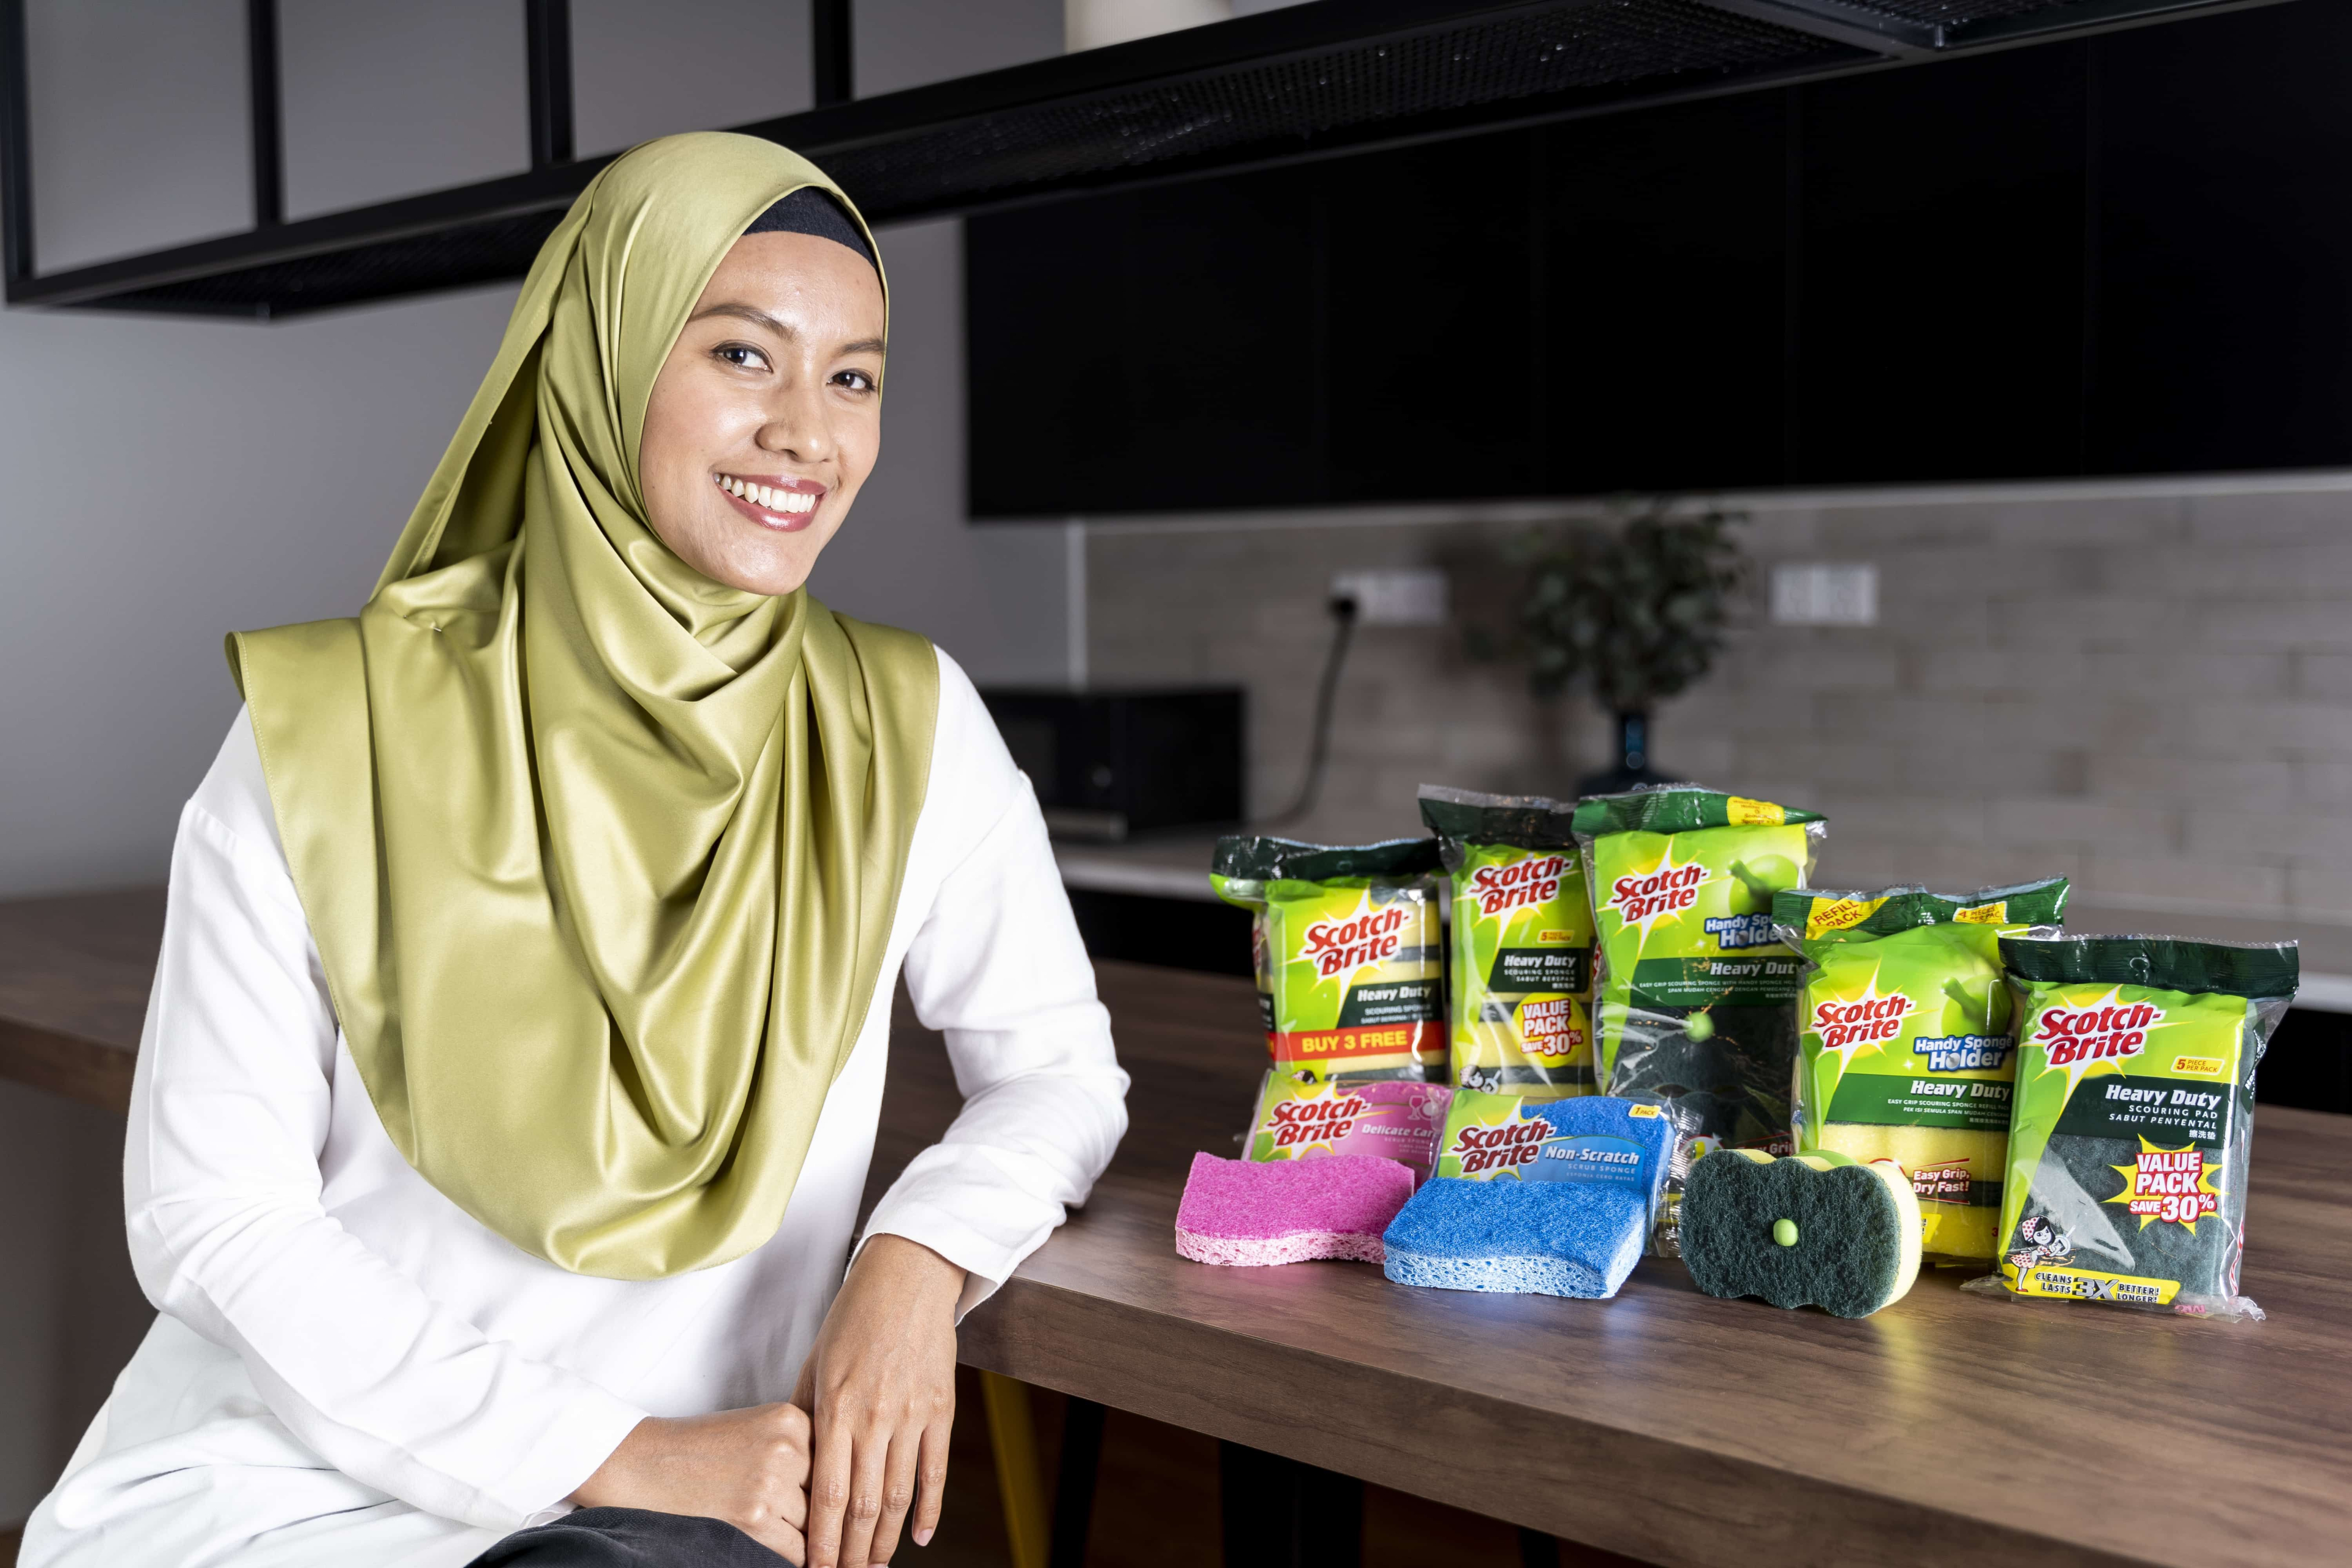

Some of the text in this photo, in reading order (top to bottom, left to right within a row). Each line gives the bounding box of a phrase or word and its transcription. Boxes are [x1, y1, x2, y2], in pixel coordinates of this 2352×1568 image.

[1470, 856, 1570, 893] Scotch-
[1611, 865, 1708, 903] Scotch-
[1480, 880, 1558, 914] Brite
[1622, 888, 1696, 922] Brite
[1814, 901, 1859, 925] REFILL
[1971, 906, 1995, 916] PIECES
[1986, 911, 2000, 919] PAC
[1305, 908, 1409, 954] Scotch-
[1706, 914, 1773, 932] Handy Spo
[1720, 925, 1780, 948] Holde
[1317, 935, 1398, 976] Brite
[1504, 955, 1577, 968] Heavy Duty
[1710, 962, 1762, 977] Heavy
[1357, 986, 1431, 1002] Heavy Duty
[1523, 999, 1570, 1019] VALUE
[1812, 995, 1912, 1028] Scotch-
[1523, 1015, 1569, 1037] PACK
[2034, 1005, 2162, 1040] Scotch-
[1302, 1030, 1408, 1053] BUY 3 FREE
[1521, 1031, 1583, 1056] SAVE 30%
[1823, 1019, 1899, 1049] Brite
[1915, 1036, 2013, 1052] Handy Sponge
[2046, 1031, 2144, 1065] Brite
[1930, 1049, 2002, 1070] Holder
[2176, 1058, 2187, 1070] 5
[1910, 1080, 2011, 1101] Heavy Duty
[2105, 1084, 2222, 1110] Heavy Duty
[1267, 1096, 1367, 1127] Scotch-
[2109, 1113, 2217, 1129] SABUT PENYENTAL
[2128, 1105, 2218, 1119] SCOURING PAD
[1276, 1119, 1352, 1147] Brite
[1362, 1123, 1411, 1136] Delicate
[1452, 1120, 1555, 1152] Scotch-
[1462, 1144, 1539, 1174] Brite
[1545, 1145, 1640, 1165] Non-Scratch
[2137, 1152, 2203, 1173] VALUE
[1600, 1166, 1636, 1174] SPONGE
[1913, 1167, 1970, 1182] Easy Grip,
[1913, 1181, 1970, 1195] Dry Fast!
[2136, 1172, 2199, 1194] PACK
[2130, 1193, 2215, 1223] SAVE 30%
[2035, 1272, 2160, 1300] CLEANS 3X BETTER!
[2041, 1282, 2157, 1303] LASTS LONGER!
